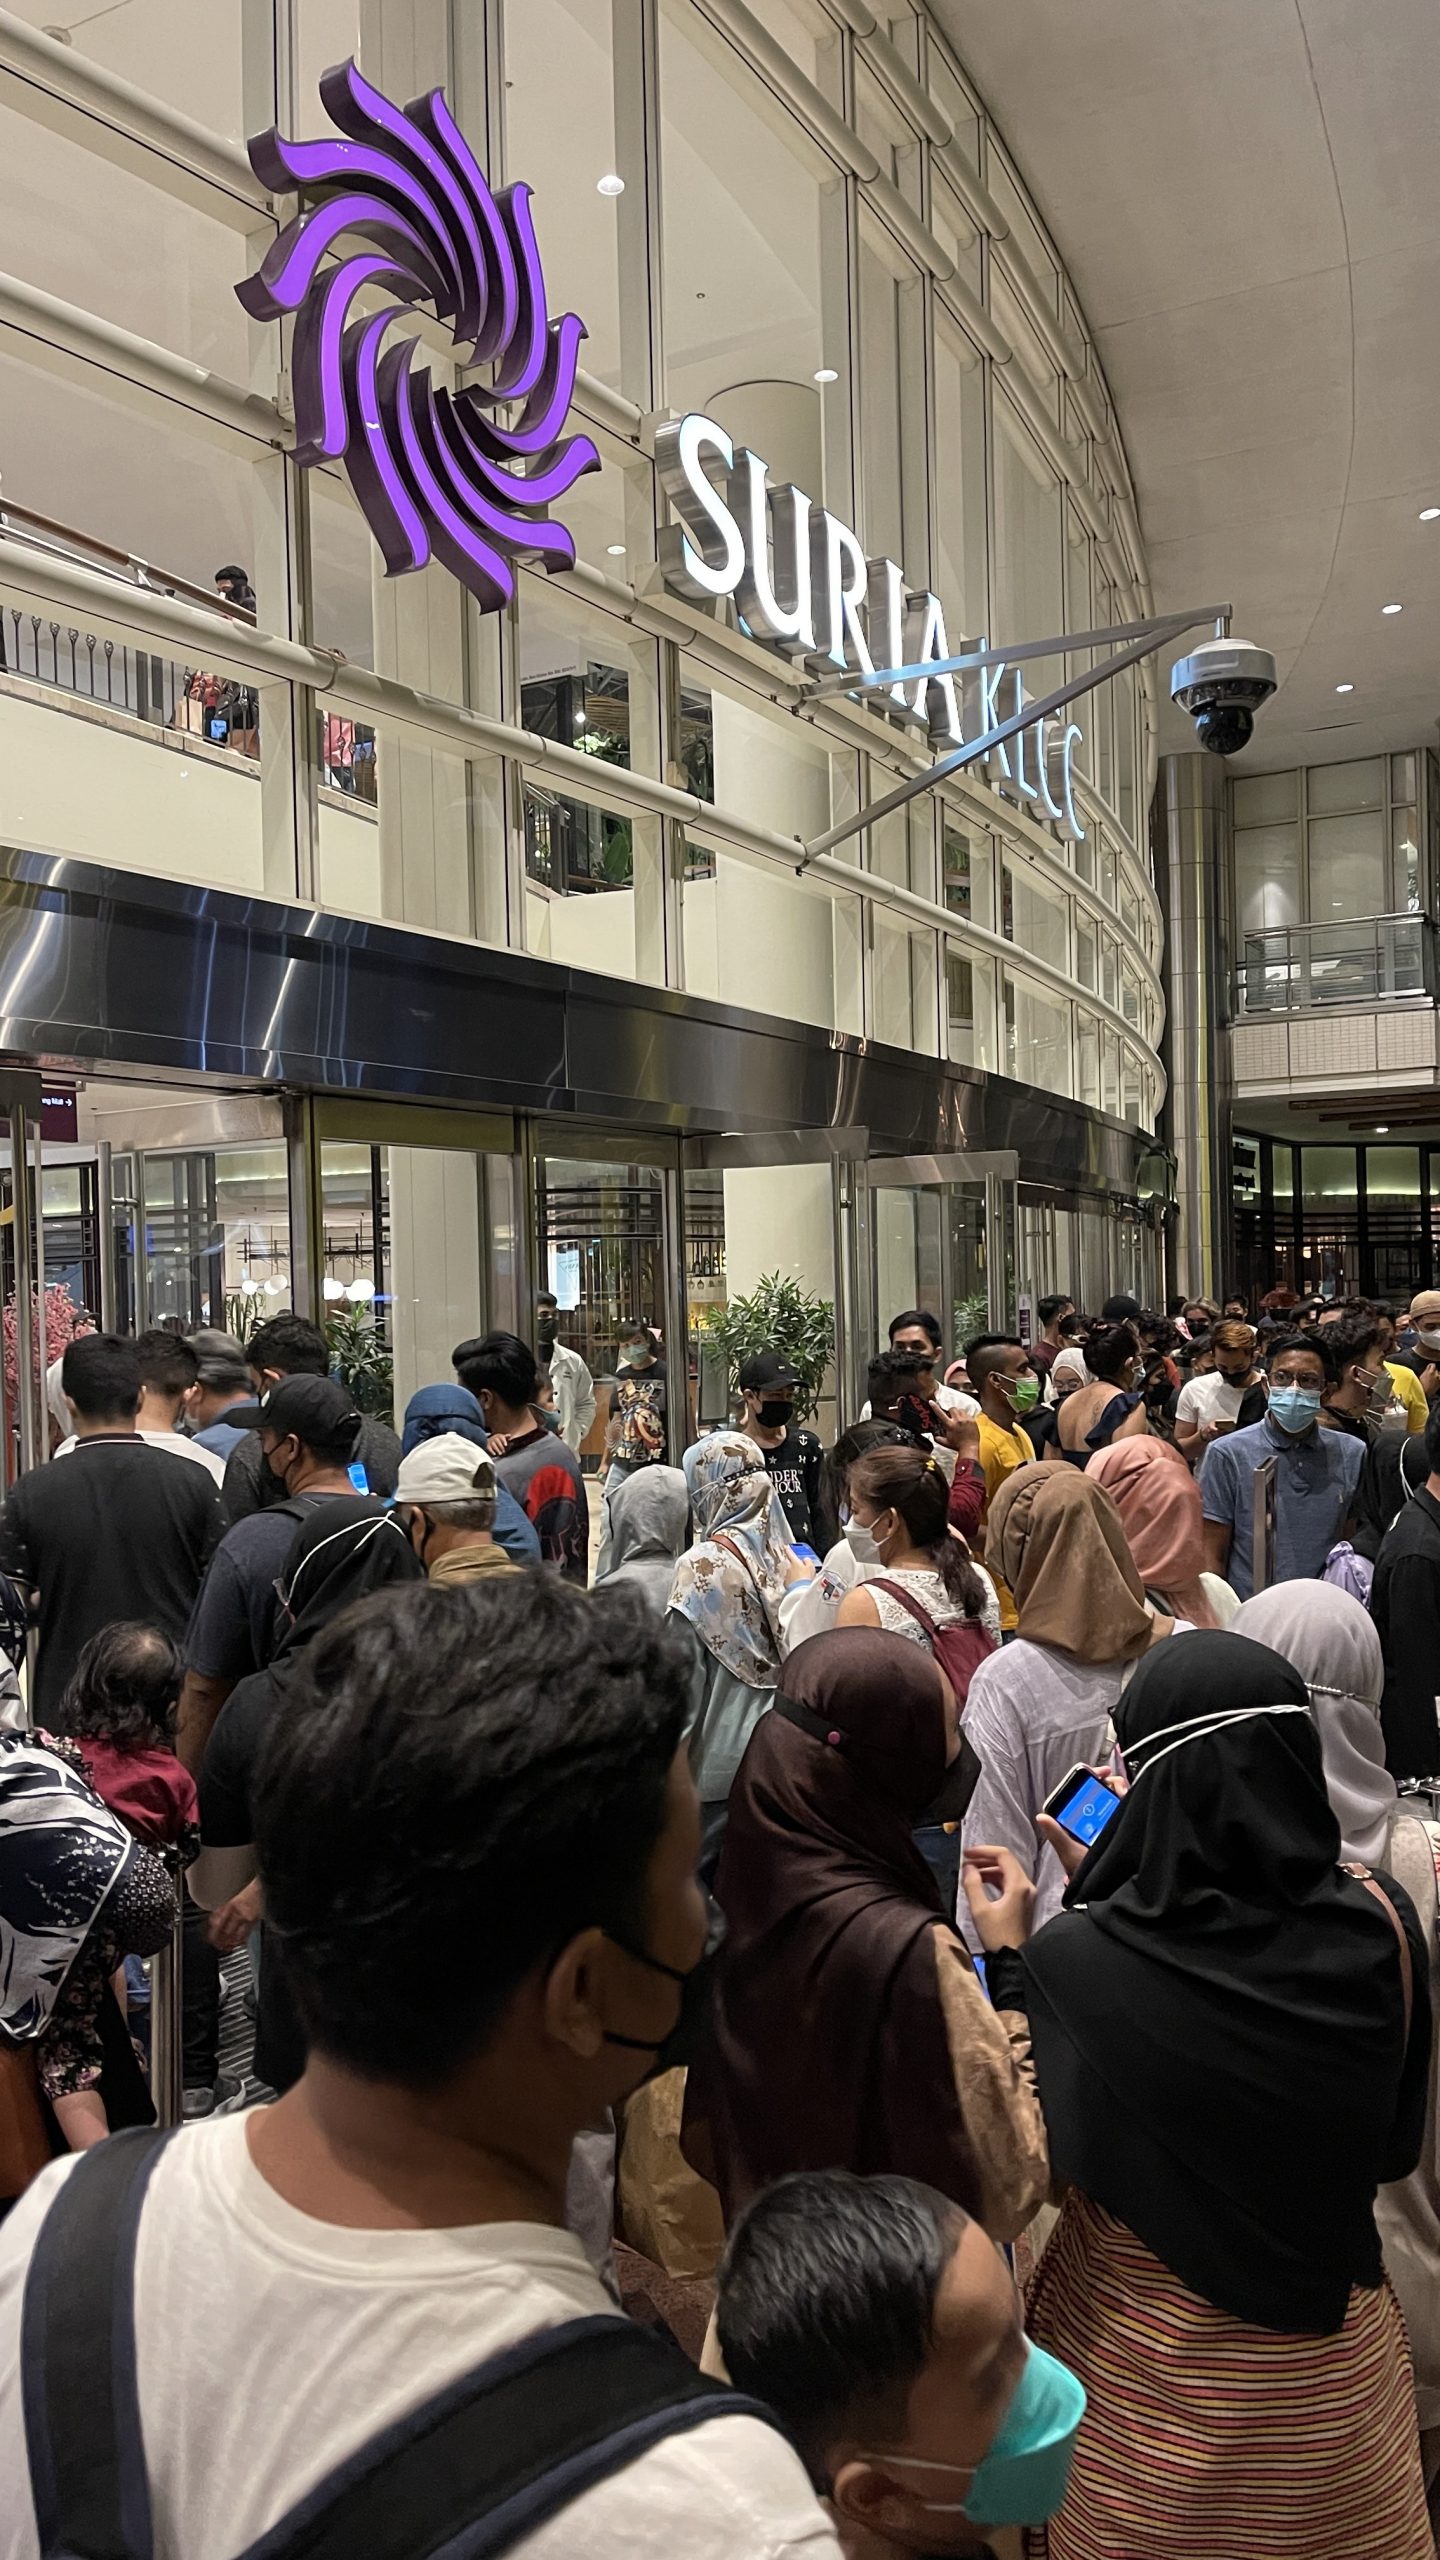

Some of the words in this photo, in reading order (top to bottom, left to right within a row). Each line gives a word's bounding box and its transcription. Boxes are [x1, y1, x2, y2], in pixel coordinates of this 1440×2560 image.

[678, 412, 964, 745] SURIA
[977, 636, 1086, 841] KLCC
[768, 1469, 799, 1483] NDER
[775, 1480, 803, 1494] OUR
